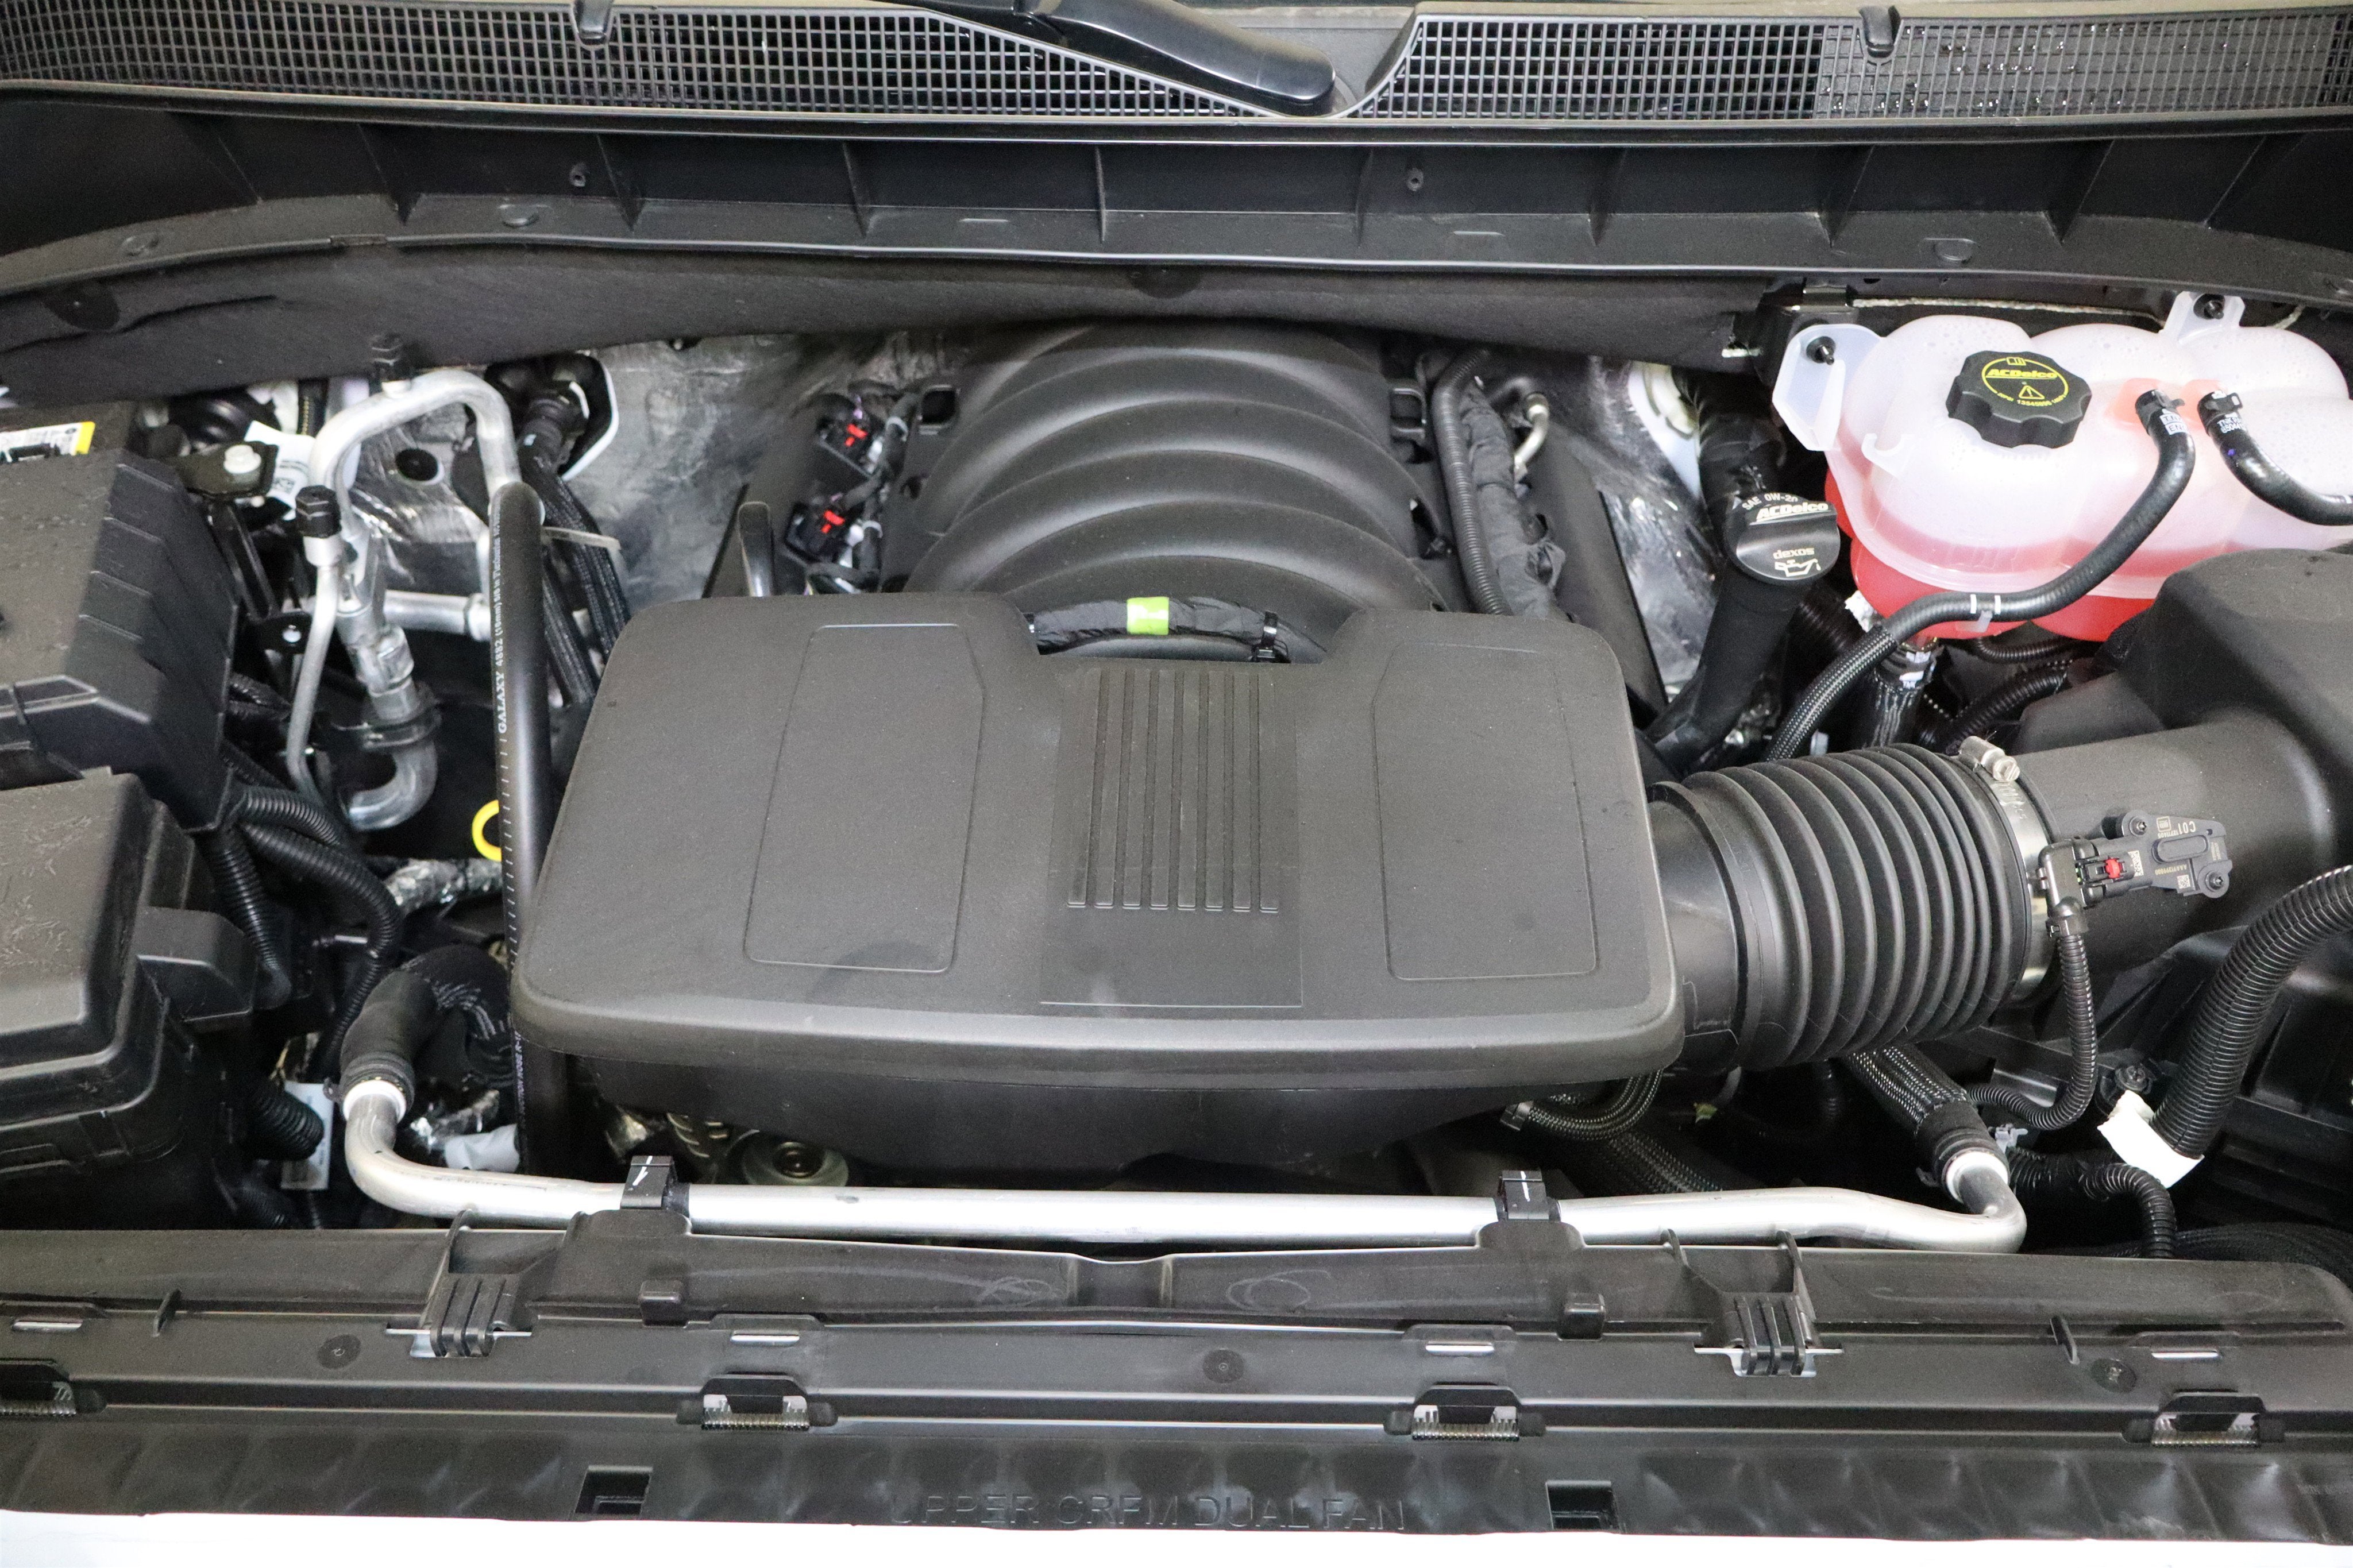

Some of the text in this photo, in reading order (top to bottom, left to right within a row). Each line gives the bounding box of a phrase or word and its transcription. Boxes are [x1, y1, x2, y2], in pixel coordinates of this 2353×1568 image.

[1986, 368, 2058, 379] ACDelco
[1742, 496, 1762, 511] SAE
[1756, 502, 1829, 522] ACDelco
[1773, 547, 1815, 559] dexos
[495, 638, 504, 666] 4882
[496, 671, 507, 734] GALAXY
[2178, 821, 2196, 835] C01
[1194, 1496, 1310, 1528] DUAL
[1322, 1499, 1405, 1531] FAN
